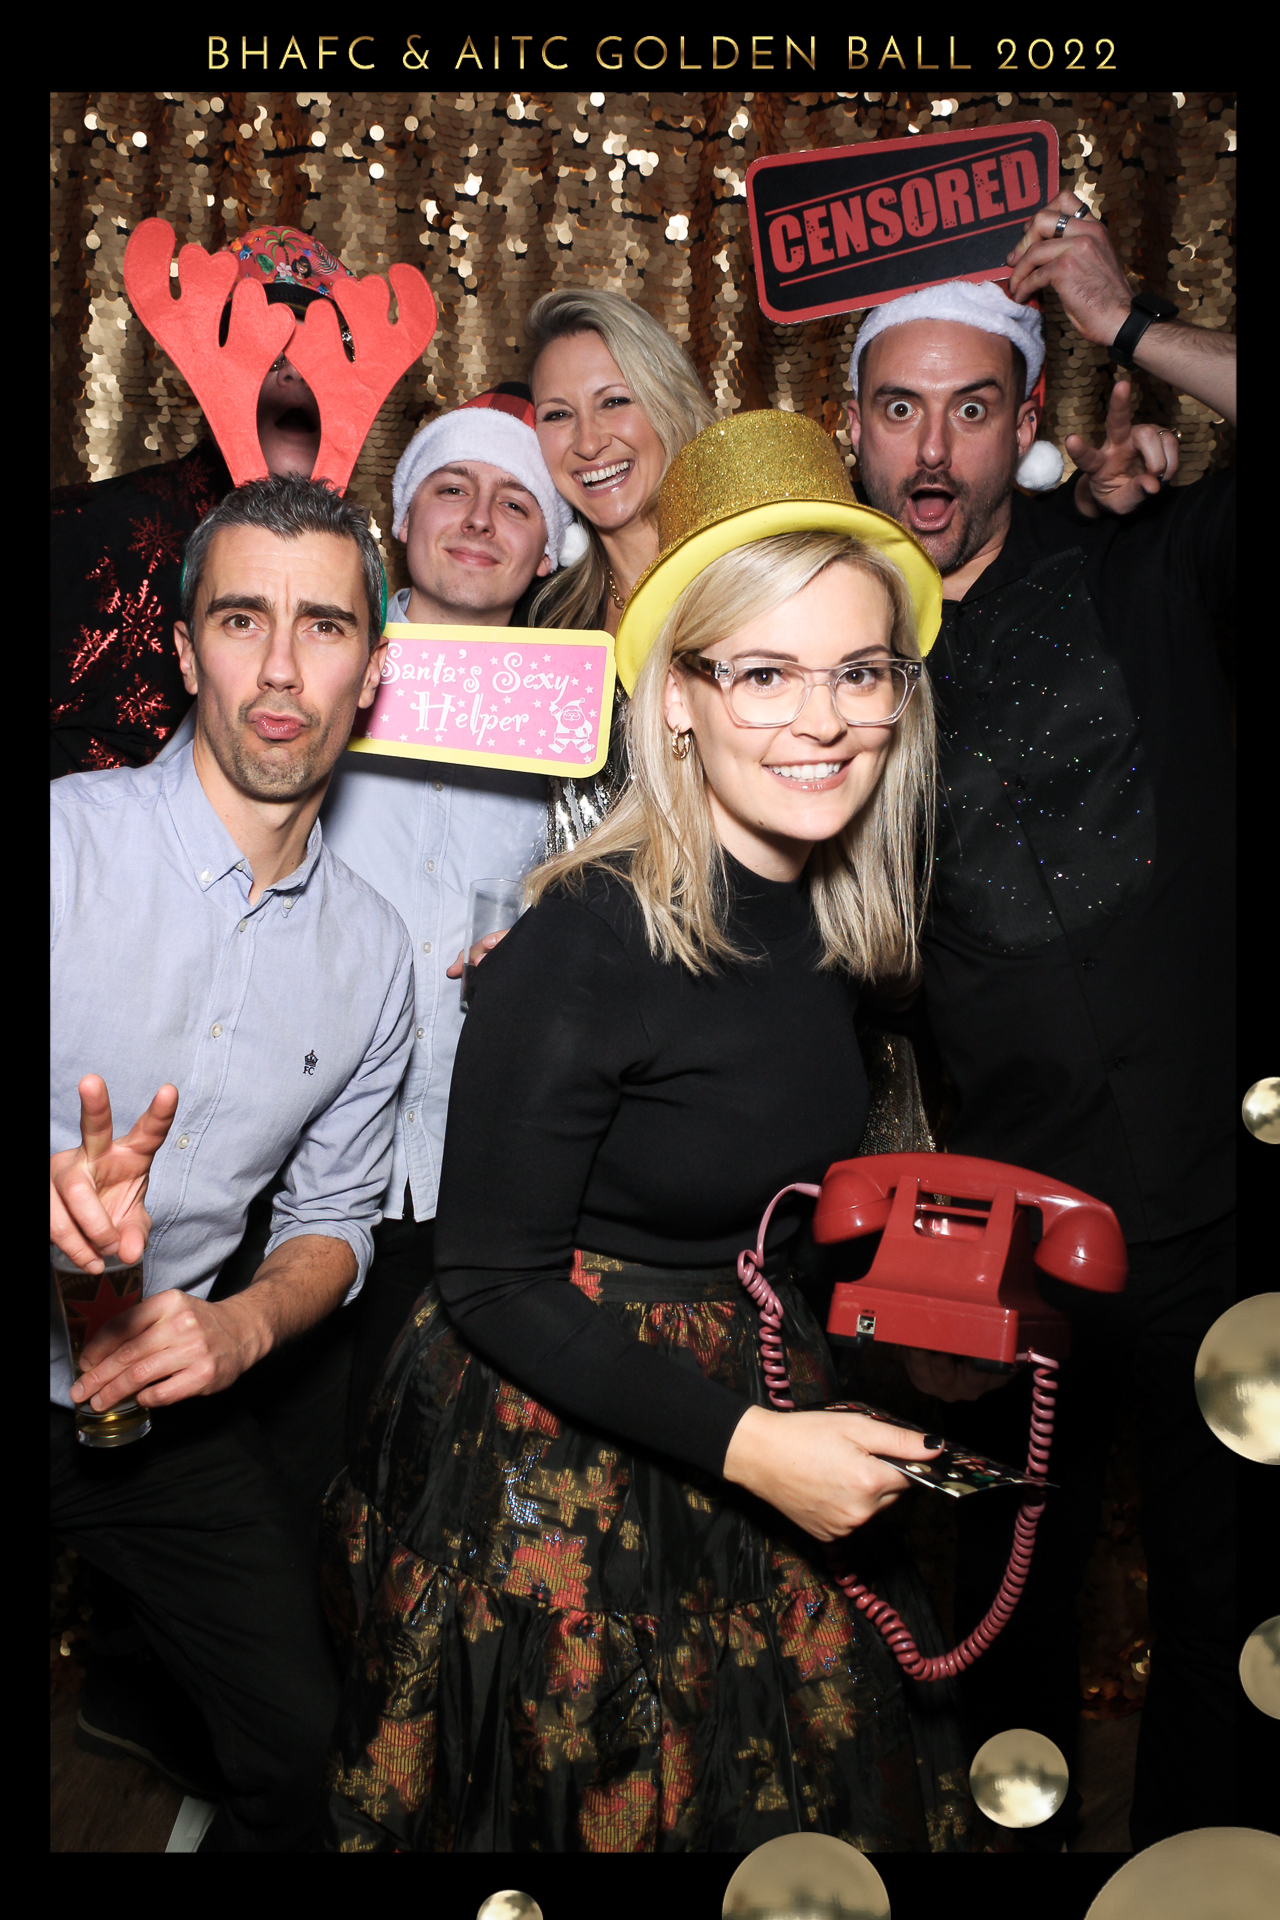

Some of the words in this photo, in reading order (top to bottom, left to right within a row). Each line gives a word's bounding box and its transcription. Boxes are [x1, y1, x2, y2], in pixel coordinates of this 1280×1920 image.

[768, 150, 1042, 273] CENSORED
[380, 642, 483, 693] Santa's
[492, 652, 570, 704] Sexy
[410, 690, 530, 746] Helper
[303, 1066, 315, 1076] FC
